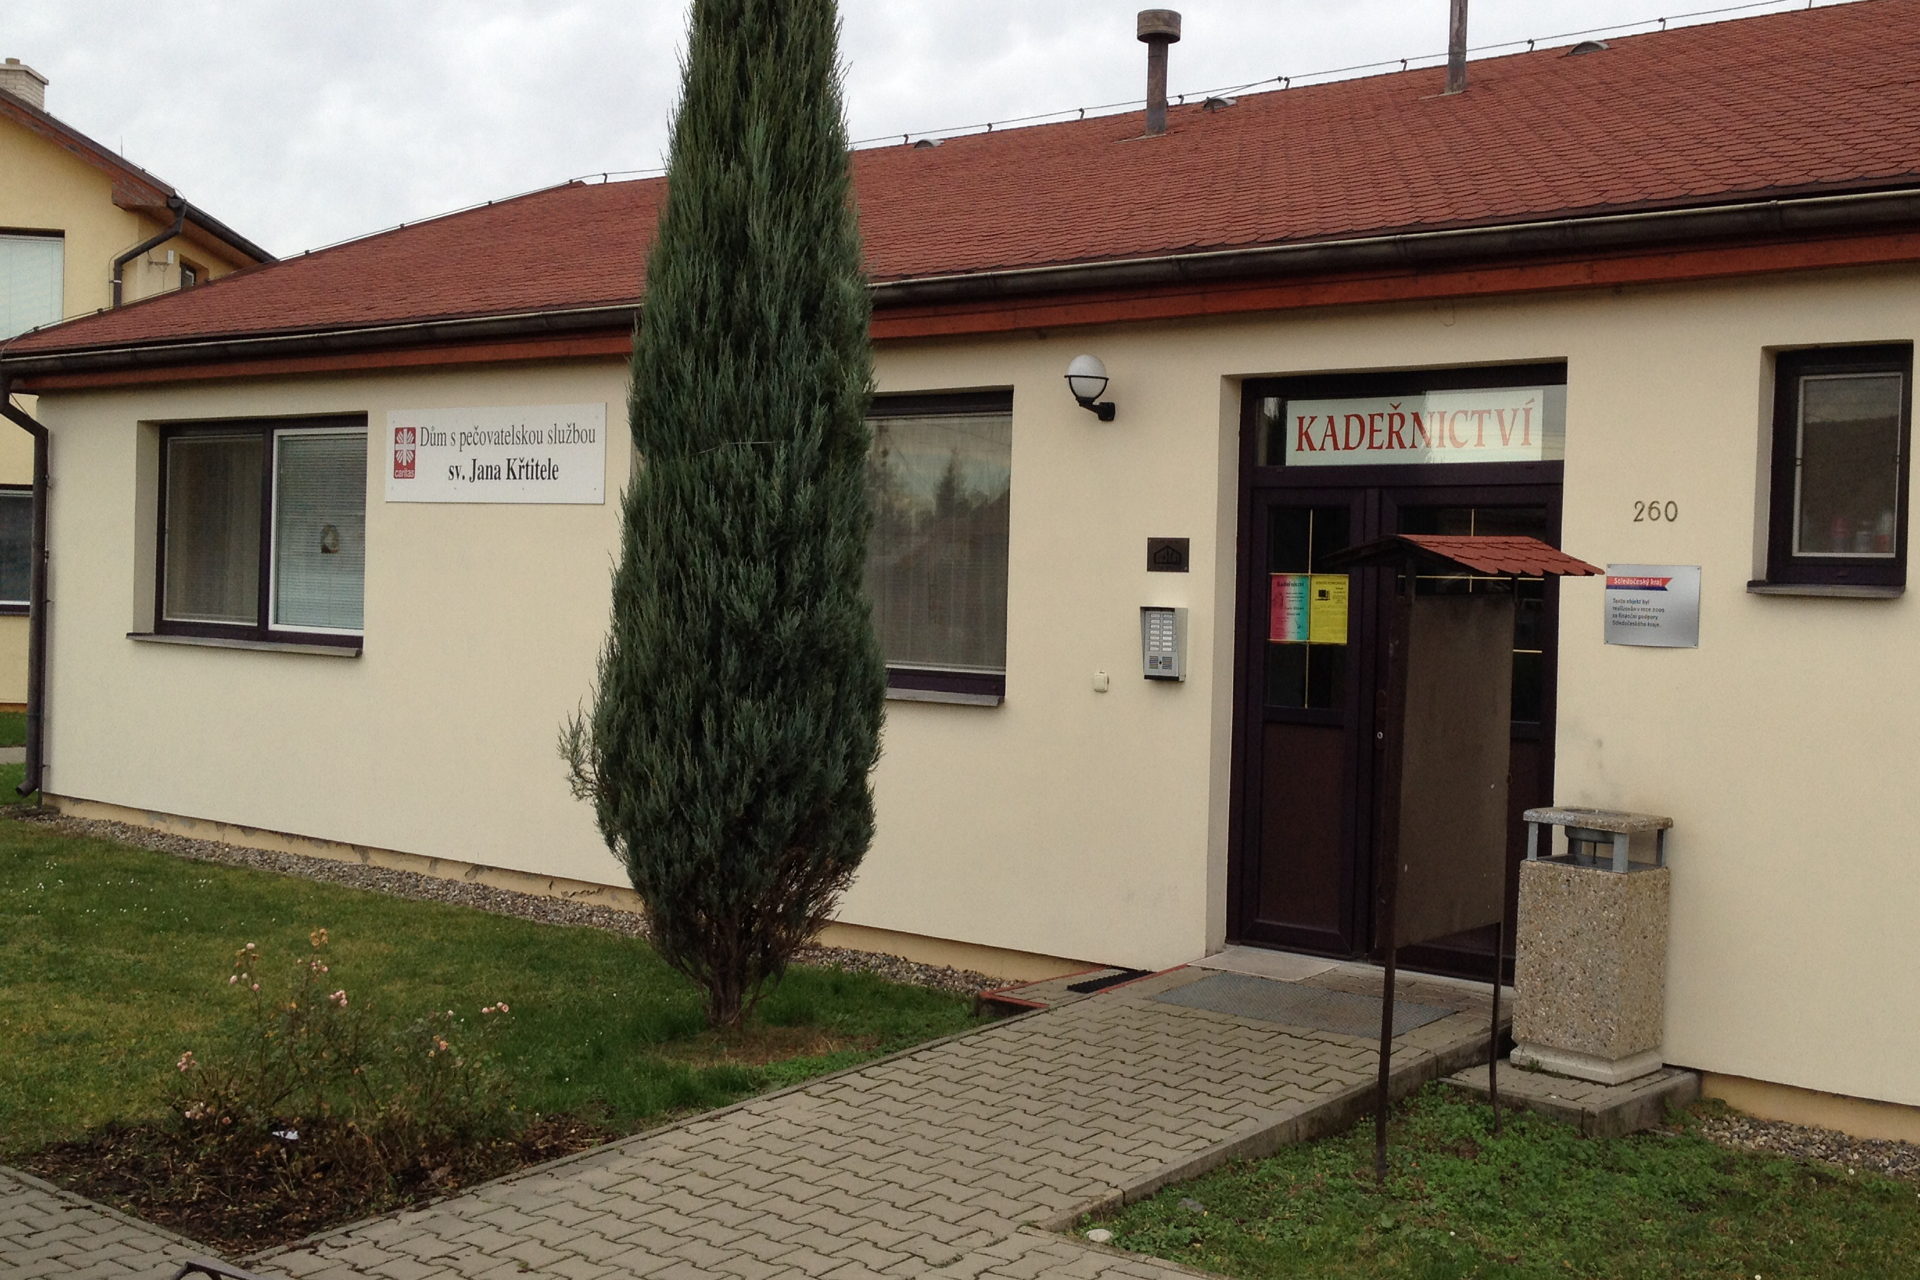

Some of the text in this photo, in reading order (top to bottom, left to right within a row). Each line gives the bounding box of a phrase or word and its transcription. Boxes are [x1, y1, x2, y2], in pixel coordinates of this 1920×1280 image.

[419, 422, 596, 452] Dům s pečovatelskou službou
[1295, 398, 1534, 452] KADEŘNICTVÍ
[448, 457, 559, 483] sv. Jana Křtitele
[1633, 500, 1678, 523] 260
[1614, 577, 1650, 586] Středočeský
